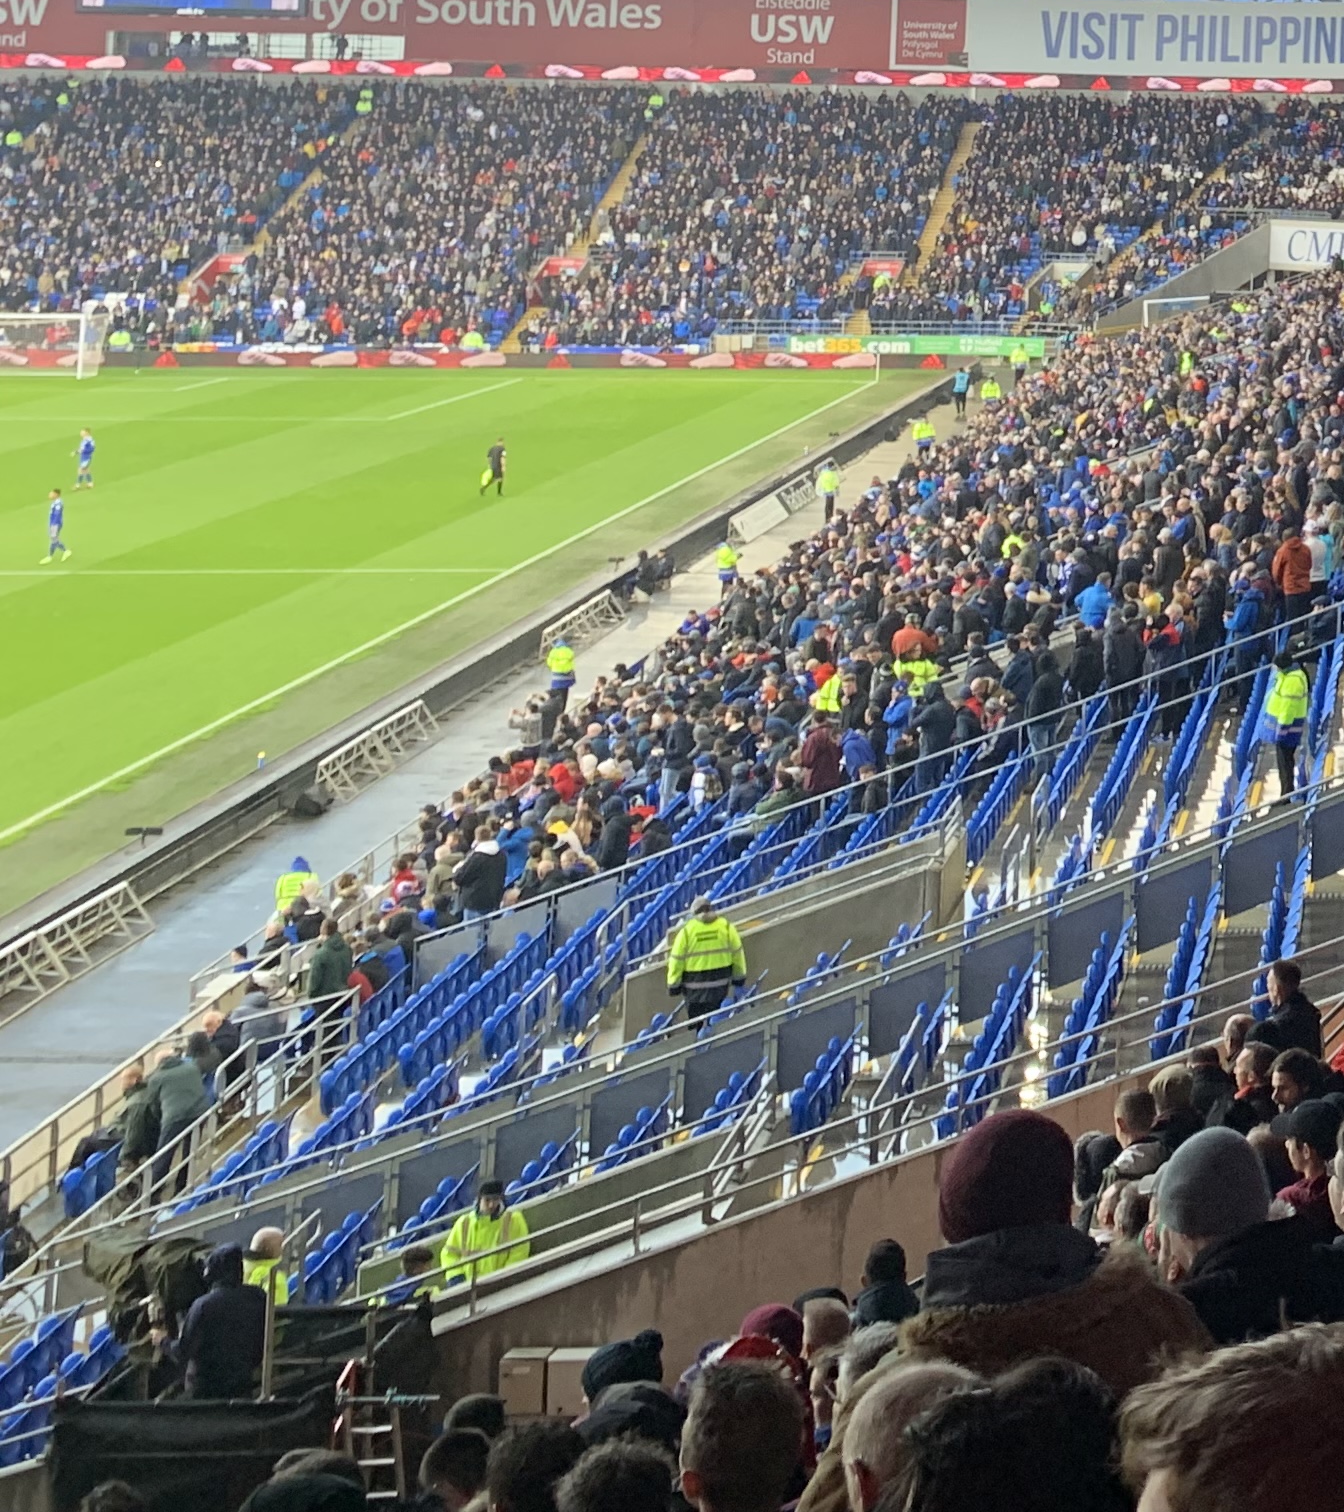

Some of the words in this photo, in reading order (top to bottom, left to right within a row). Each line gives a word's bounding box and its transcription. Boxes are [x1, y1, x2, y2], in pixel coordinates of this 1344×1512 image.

[751, 13, 835, 44] USW
[903, 30, 929, 39] South
[1041, 10, 1145, 62] VISIT
[766, 47, 815, 65] Stand
[790, 336, 911, 354] bet365.com
